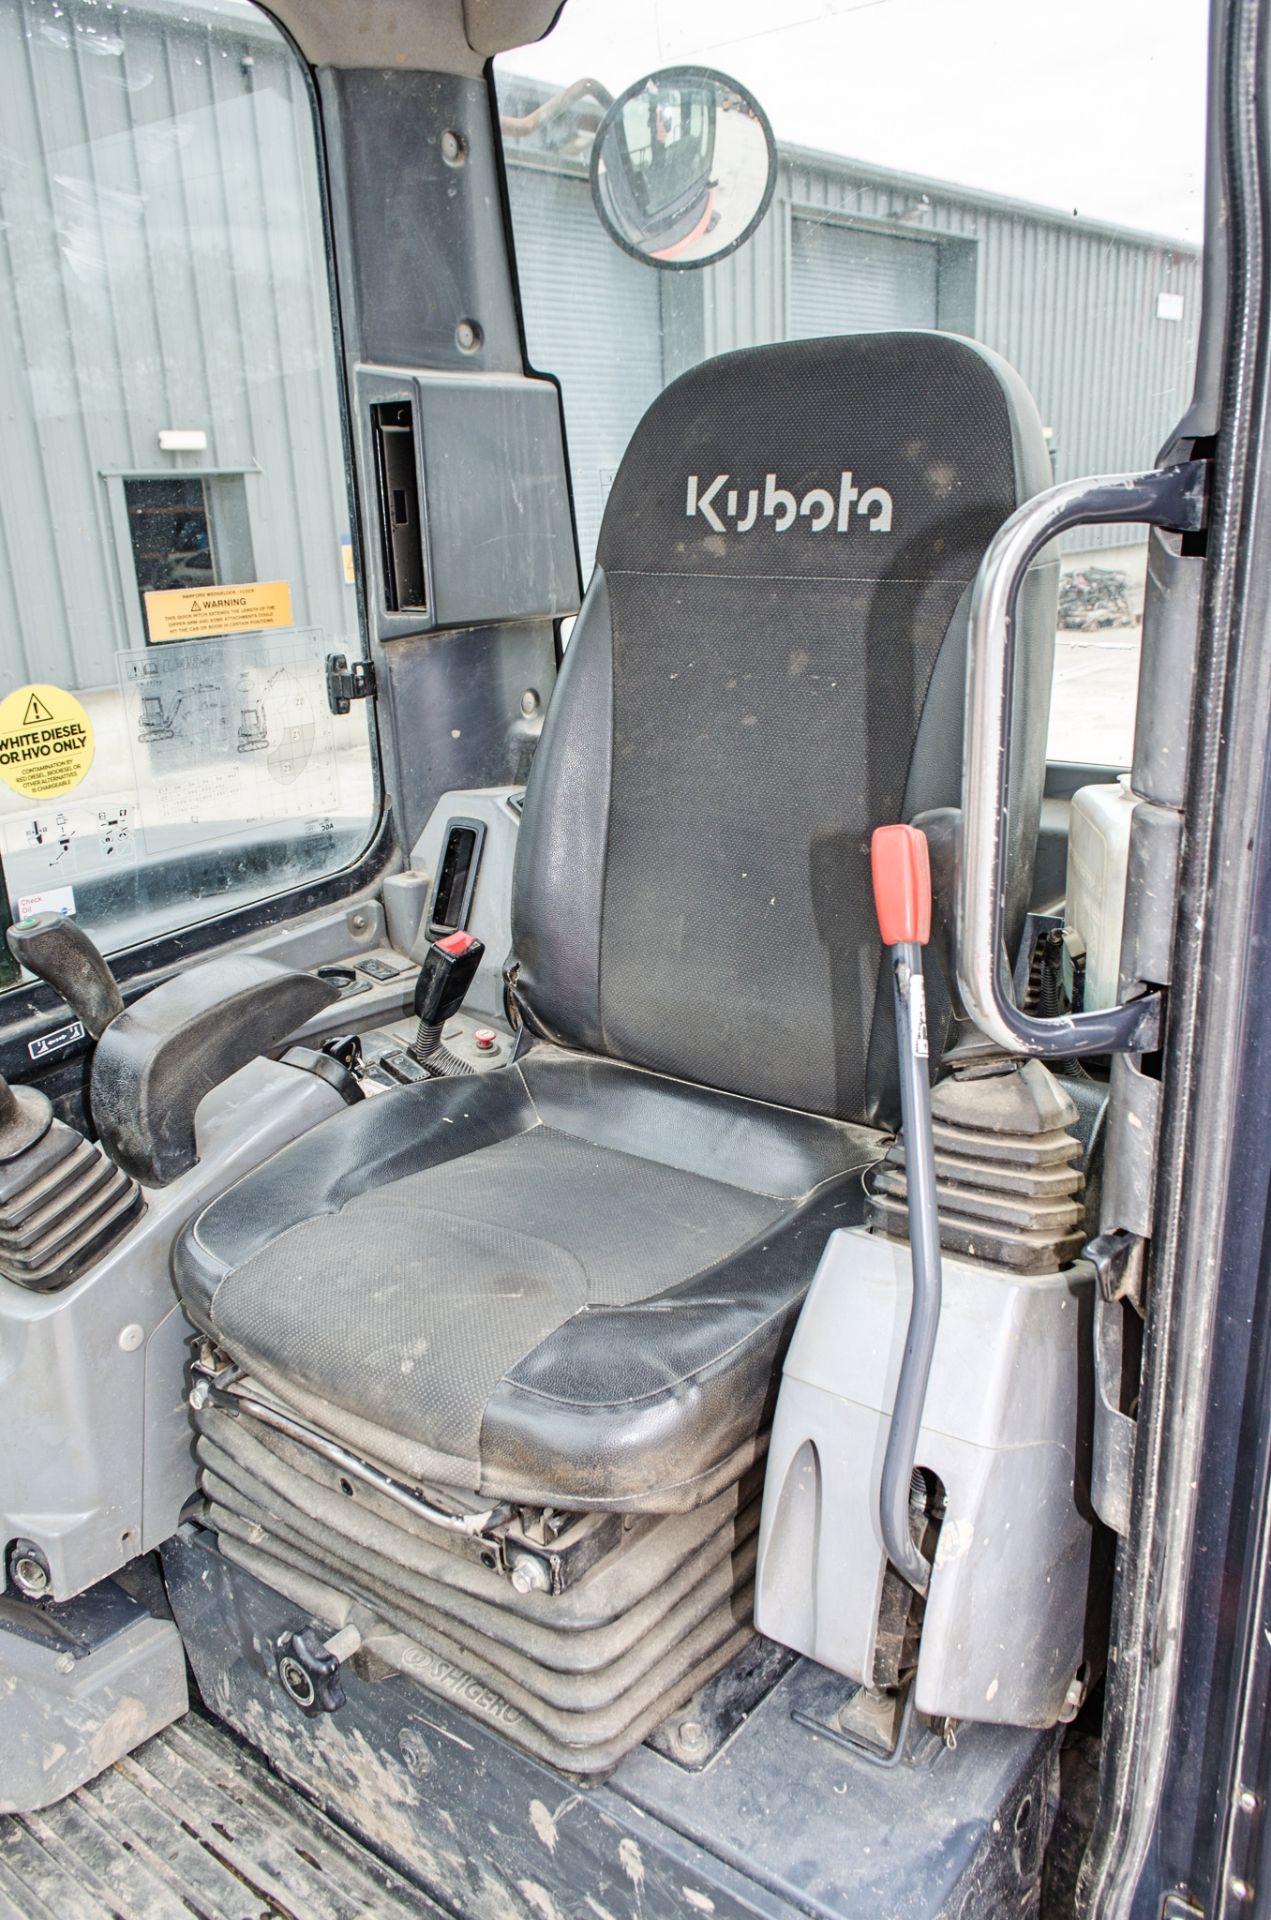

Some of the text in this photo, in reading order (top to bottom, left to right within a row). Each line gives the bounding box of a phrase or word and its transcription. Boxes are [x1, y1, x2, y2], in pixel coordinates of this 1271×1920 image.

[686, 471, 894, 532] Kubota
[202, 598, 247, 609] WARNING
[0, 724, 86, 751] WHITE DIESEL
[0, 736, 87, 765] OR HVO ONLY
[22, 760, 65, 774] CONTAMINATION
[47, 767, 72, 776] BIODIESEL
[22, 771, 78, 788] OTHER ALTERNATIVES
[37, 780, 71, 792] CHARGEABLE
[20, 896, 43, 906] Check
[430, 1662, 522, 1725] SHIGERU
